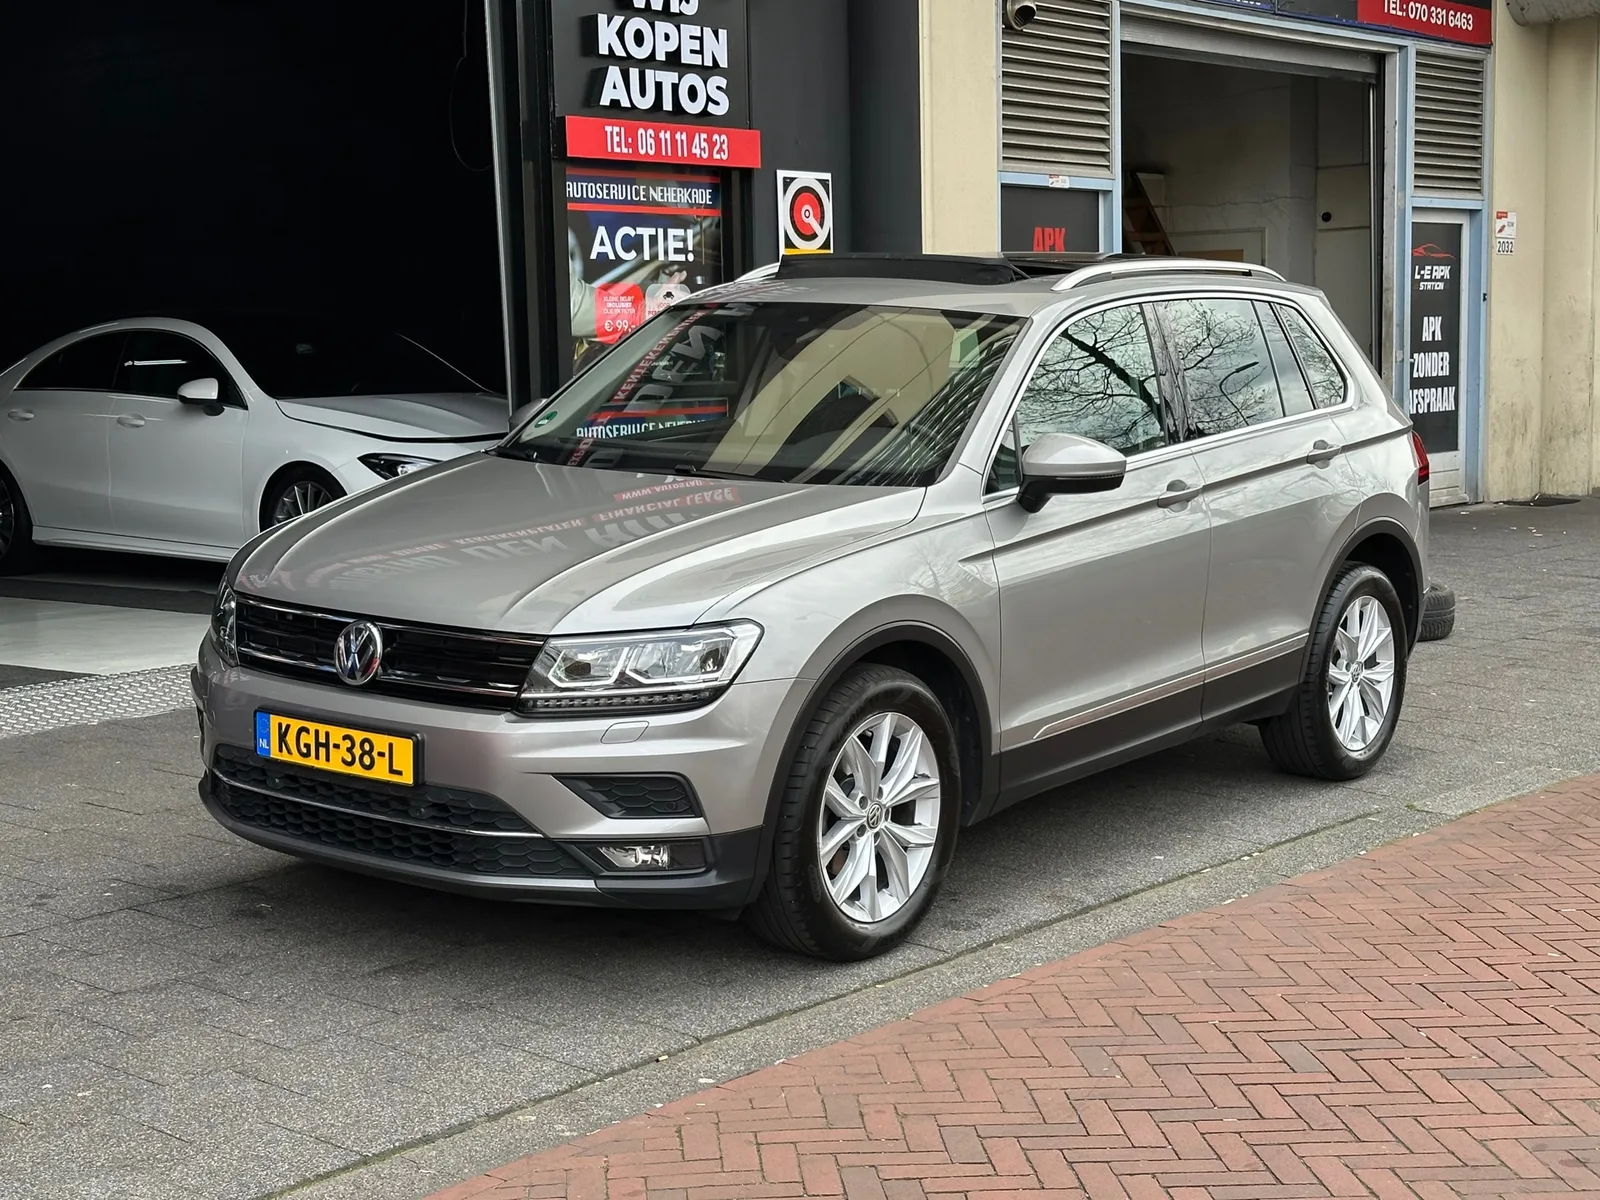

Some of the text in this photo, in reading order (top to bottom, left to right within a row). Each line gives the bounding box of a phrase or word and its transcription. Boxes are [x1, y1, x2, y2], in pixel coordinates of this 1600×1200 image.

[1384, 0, 1474, 31] TEL: 070 331 6463
[597, 13, 728, 68] KOPEN
[599, 65, 729, 116] AUTOS
[604, 125, 729, 161] TEL: 06 11 11 45 23
[566, 181, 713, 205] AUTOSERVICE NEHERKADE
[589, 225, 695, 262] ACTIE!
[1033, 227, 1066, 252] APK
[1497, 240, 1514, 253] 2032
[1419, 281, 1444, 291] STATION
[604, 321, 614, 332] €
[1422, 316, 1442, 342] APK
[1413, 352, 1450, 378] ZONDER
[259, 738, 269, 749] NL
[277, 722, 404, 776] KGH-38-L
